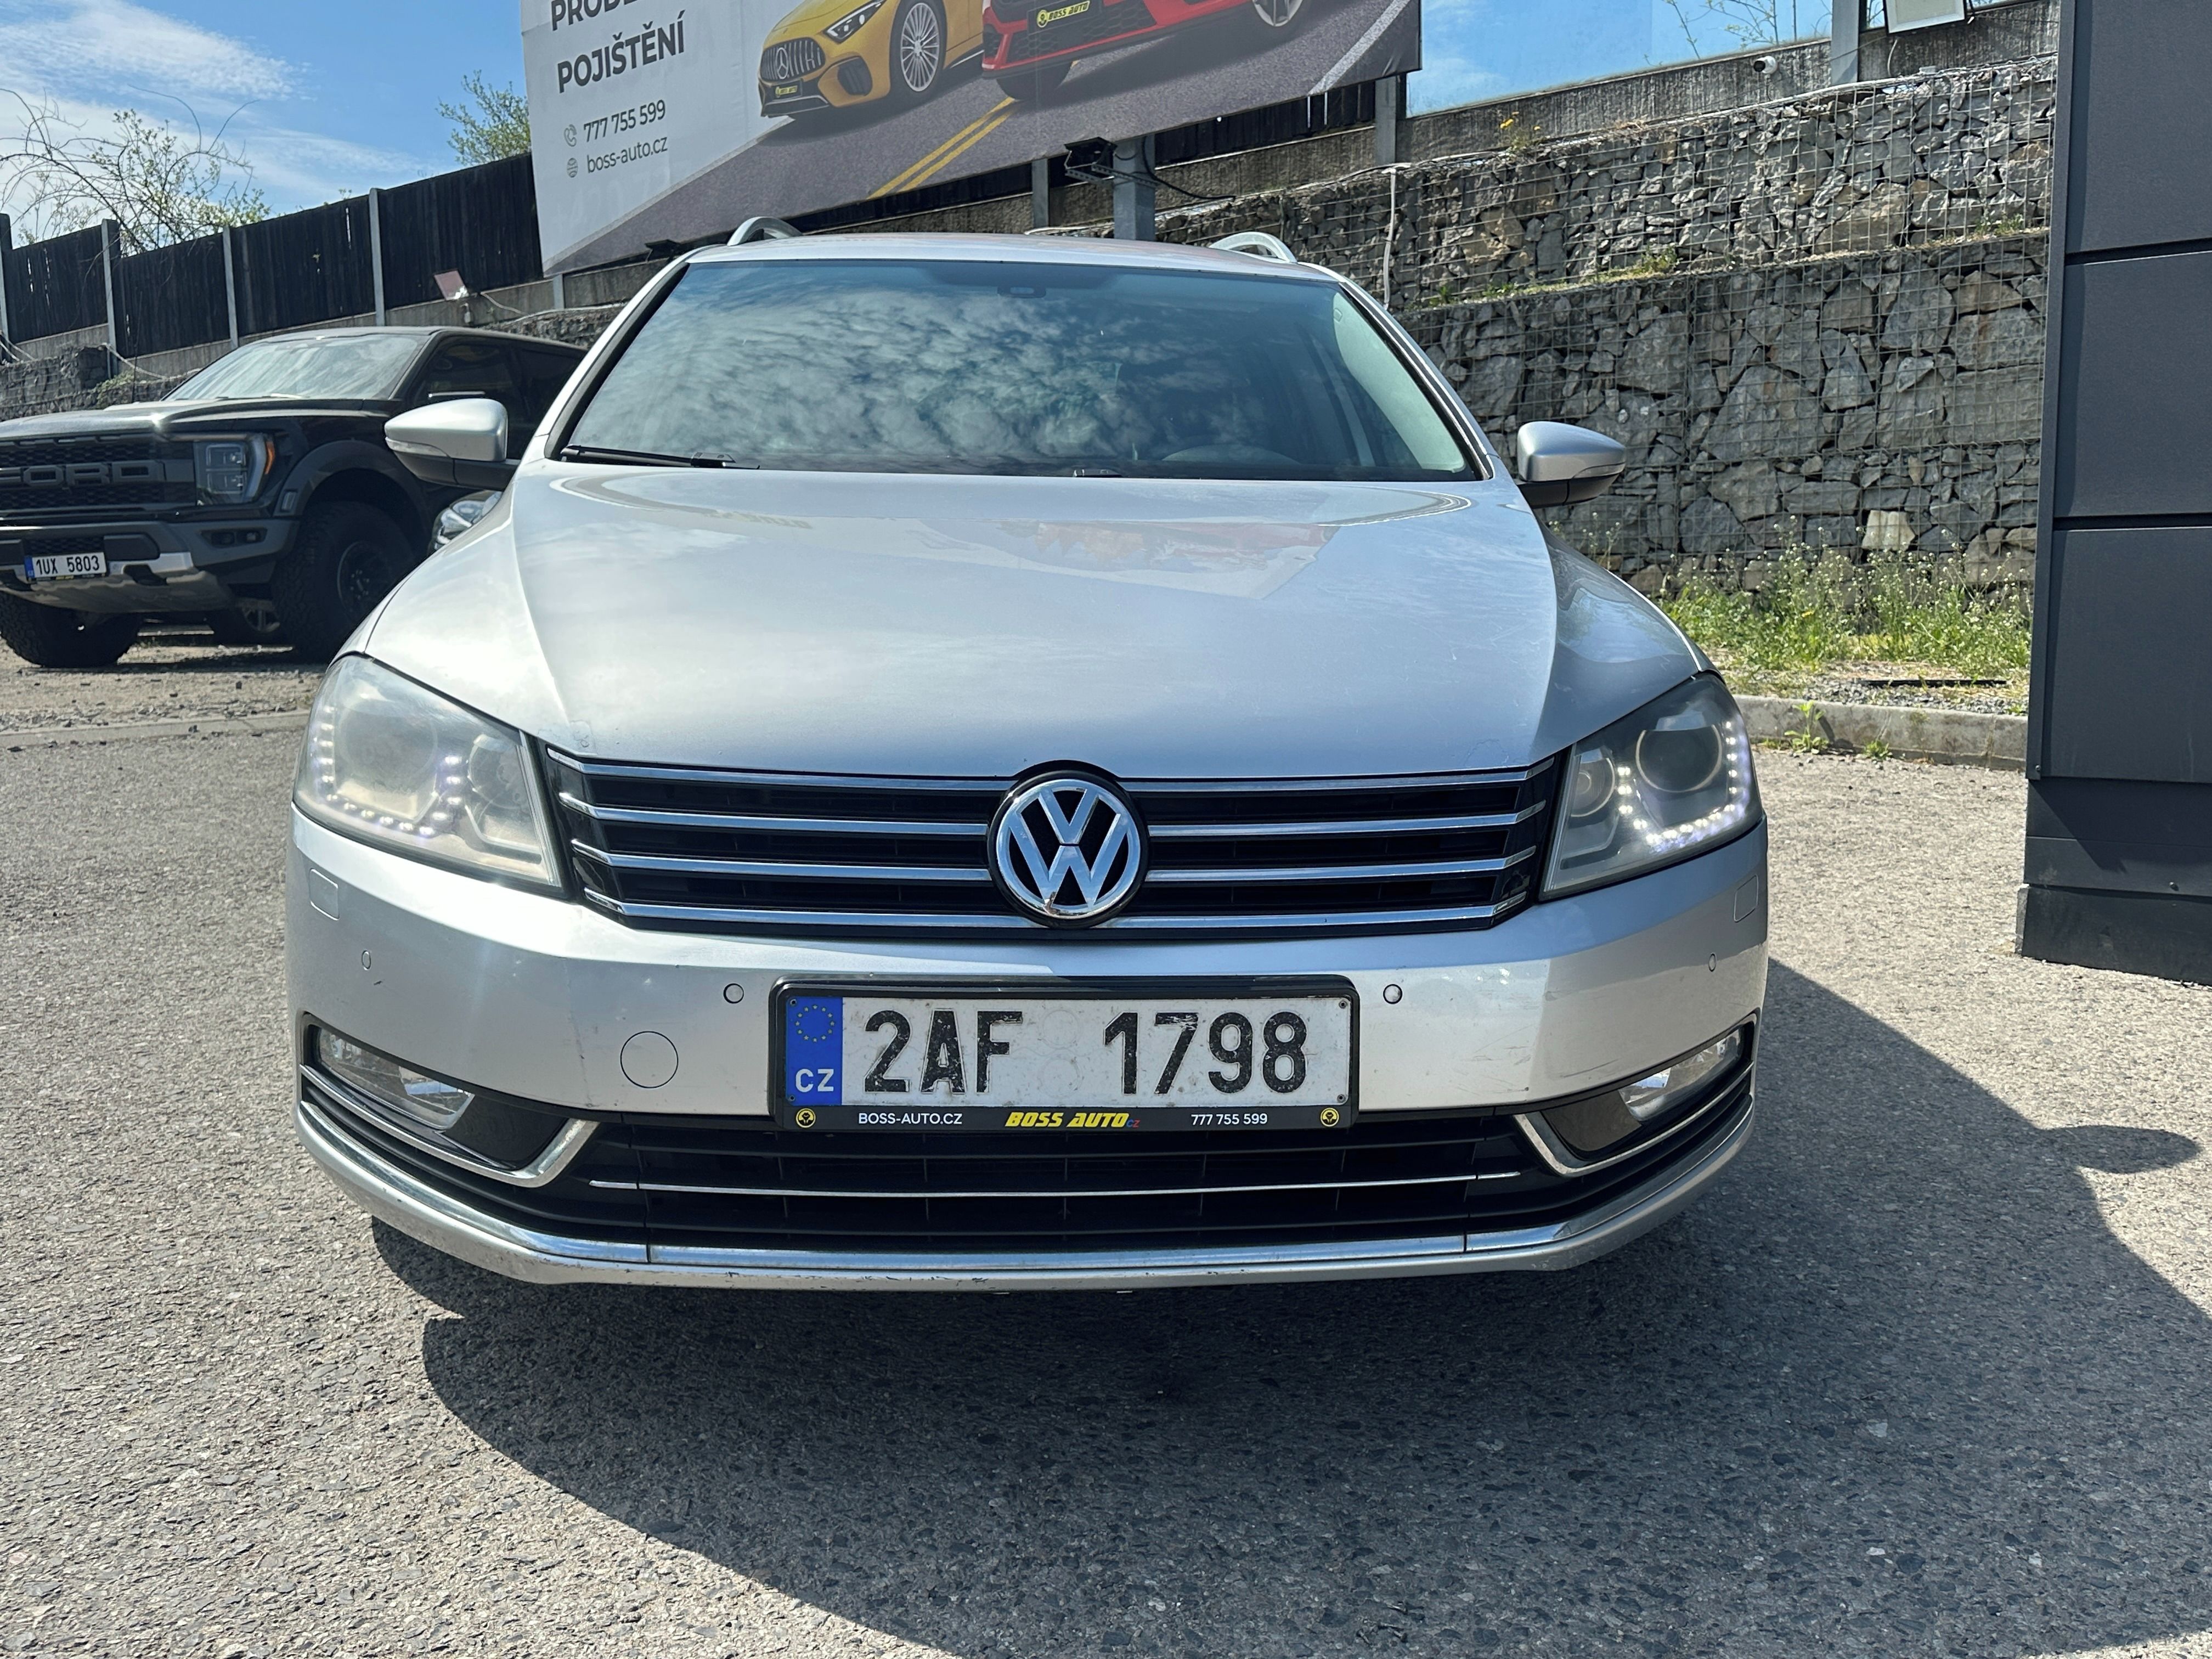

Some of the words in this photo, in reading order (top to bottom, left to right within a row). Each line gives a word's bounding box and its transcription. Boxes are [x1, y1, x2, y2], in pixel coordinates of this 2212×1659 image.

[551, 0, 637, 31] PRO
[557, 9, 685, 93] POJIŠTĚNÍ
[584, 117, 608, 142] 777
[611, 108, 636, 134] 755
[640, 99, 665, 125] 599
[586, 137, 668, 173] boss-auto.cz
[36, 557, 58, 575] 1UX
[66, 555, 99, 573] 5803
[863, 1009, 1024, 1094] 2AF
[1103, 1011, 1308, 1096] 1798
[795, 1069, 834, 1092] CZ
[858, 1112, 963, 1125] BOSS-AUTO.CZ
[1005, 1111, 1064, 1127] BOSS
[1066, 1113, 1130, 1127] AUTO
[1191, 1114, 1213, 1125] 777
[1216, 1113, 1240, 1125] 755
[1243, 1113, 1268, 1125] 599
